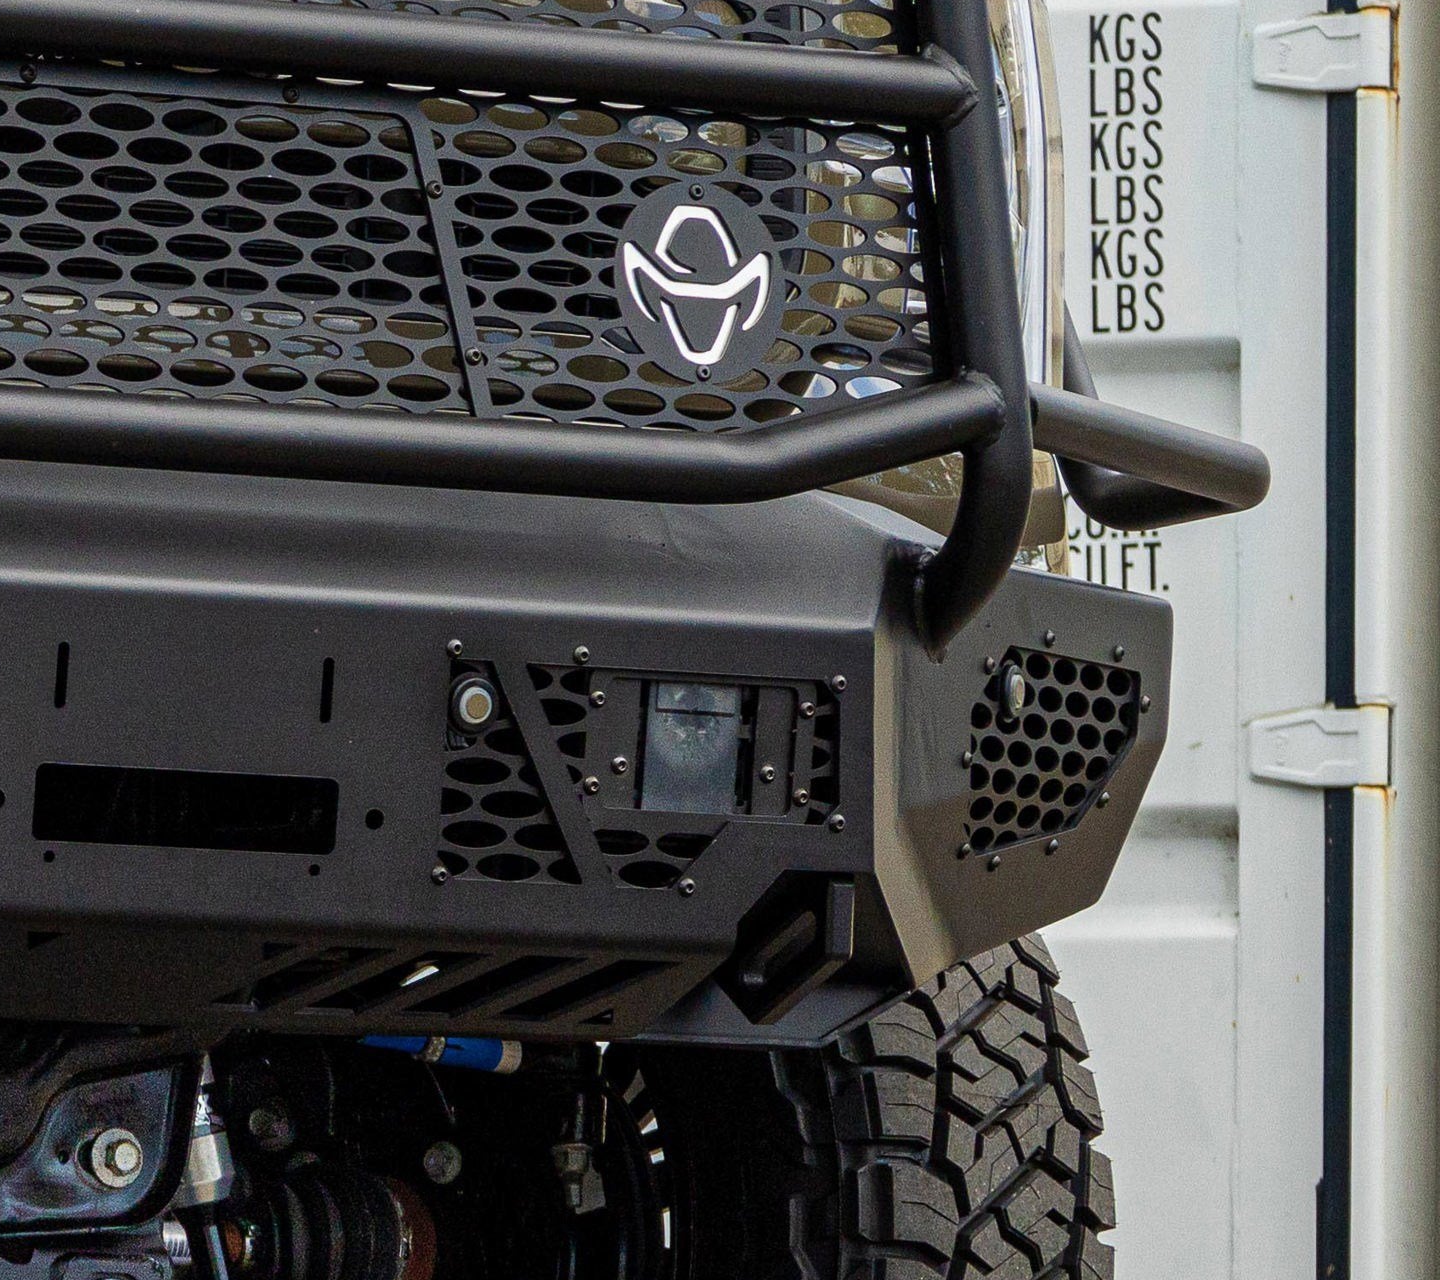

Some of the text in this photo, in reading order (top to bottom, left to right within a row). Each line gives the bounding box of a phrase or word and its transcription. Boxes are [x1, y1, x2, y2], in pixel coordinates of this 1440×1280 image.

[1089, 11, 1163, 64] KGS
[1089, 65, 1163, 118] LBS
[1090, 119, 1164, 172] KGS
[1090, 173, 1164, 226] LBS
[1091, 228, 1165, 280] KGS
[1091, 281, 1165, 334] LBS
